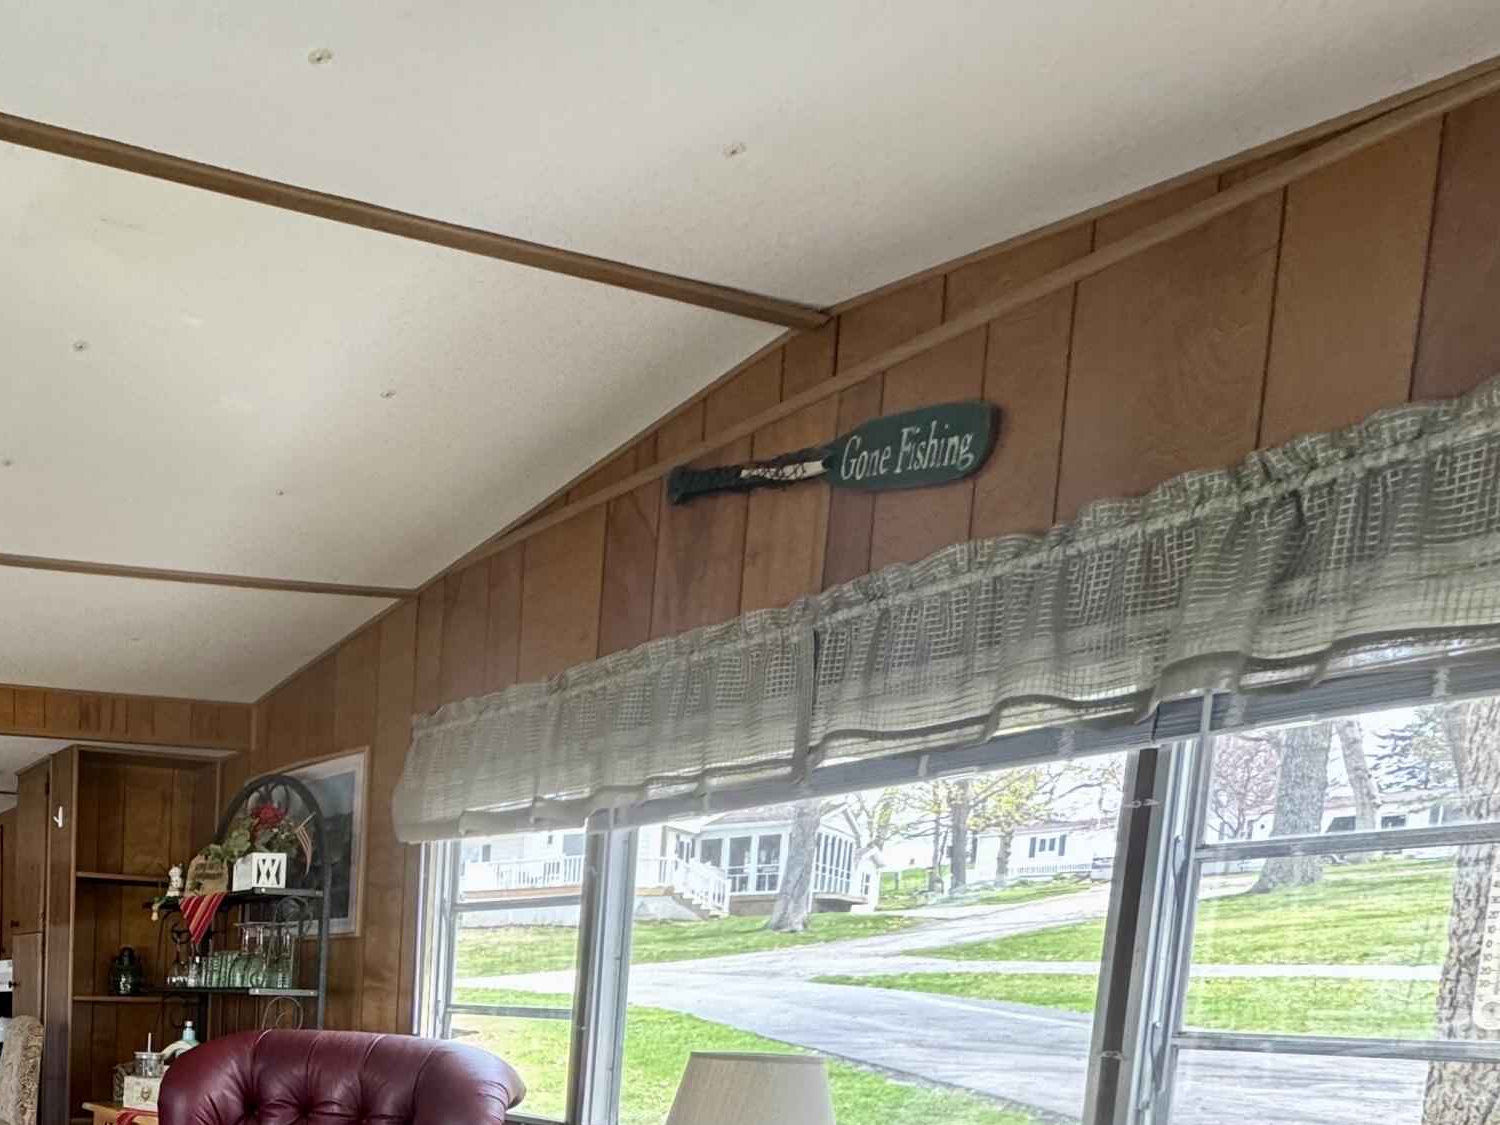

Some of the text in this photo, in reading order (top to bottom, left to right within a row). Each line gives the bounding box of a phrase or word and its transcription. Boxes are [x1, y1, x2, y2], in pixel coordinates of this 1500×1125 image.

[841, 420, 975, 480] Gone Fishing
[1488, 925, 1496, 934] 10
[1486, 939, 1493, 948] 0
[1483, 953, 1493, 962] 10
